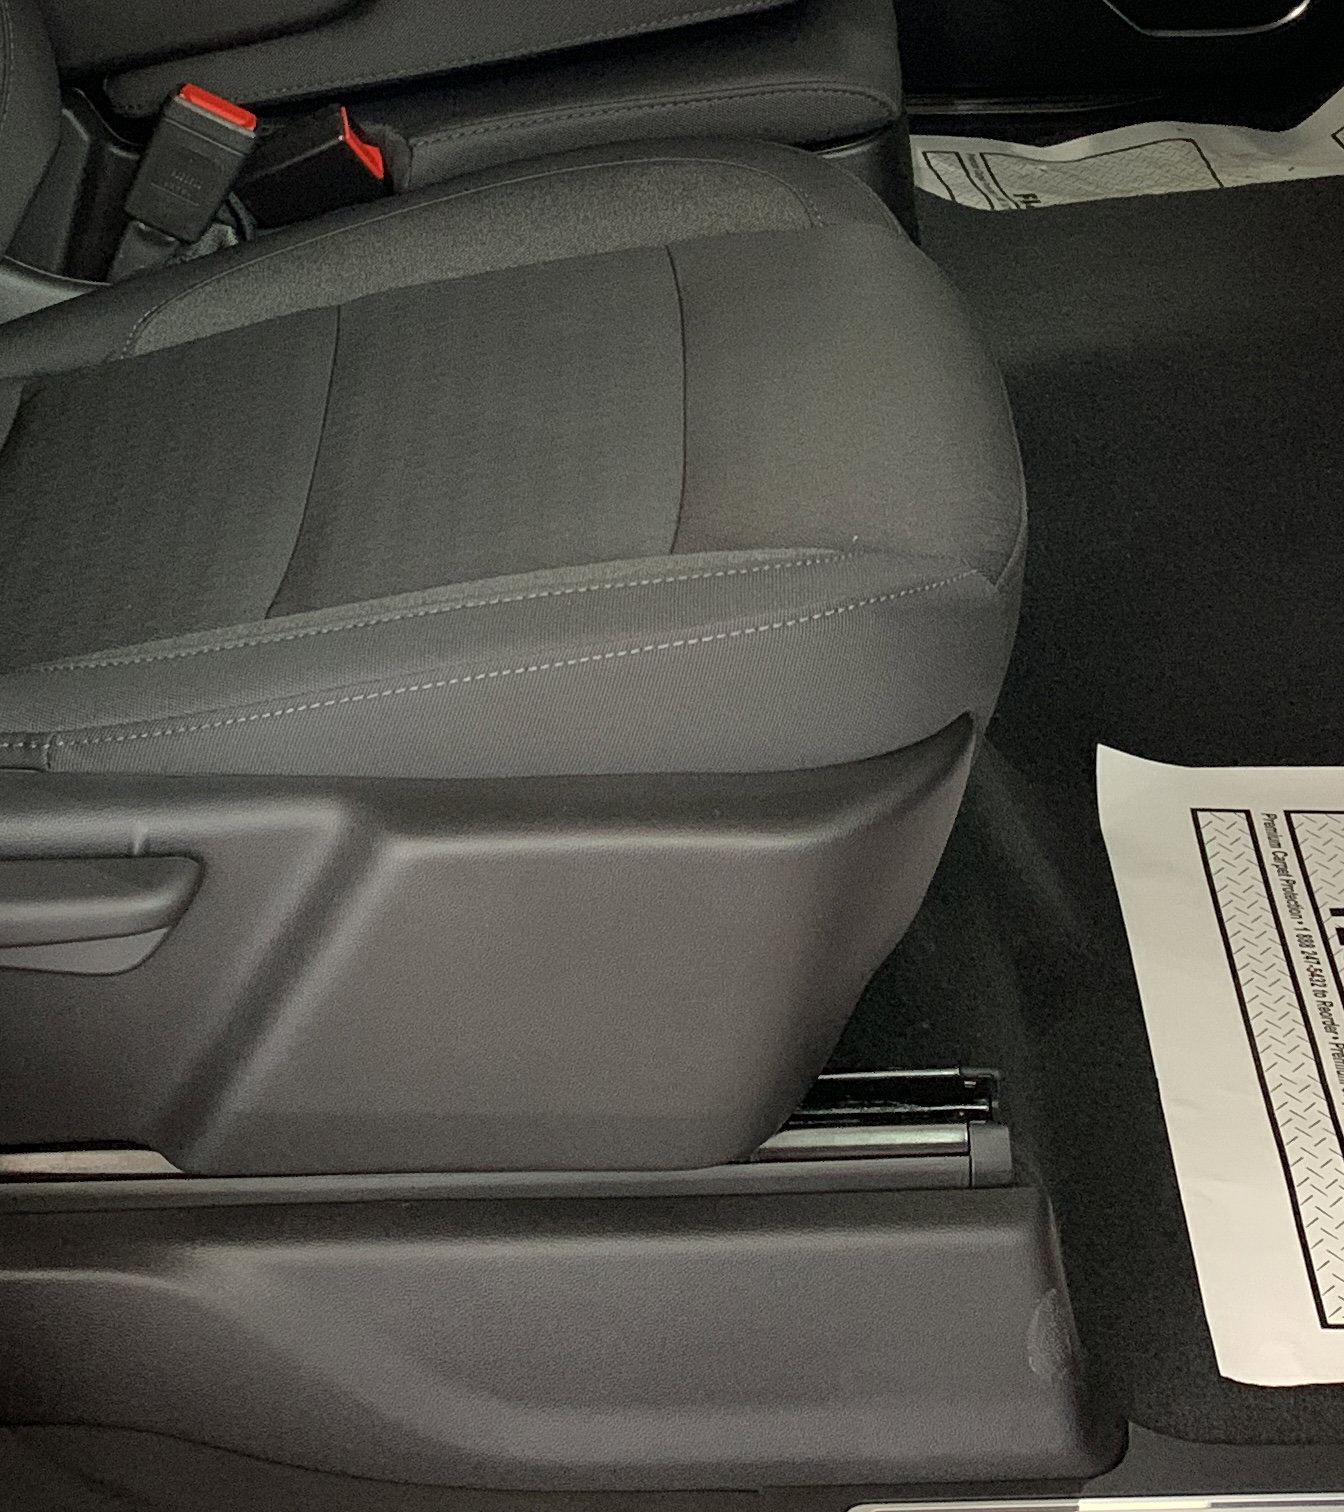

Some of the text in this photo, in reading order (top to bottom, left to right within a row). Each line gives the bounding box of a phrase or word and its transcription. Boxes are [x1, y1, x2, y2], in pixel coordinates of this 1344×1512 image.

[1261, 812, 1283, 849] Premium
[1271, 850, 1293, 877] Carpet
[1279, 877, 1305, 920] Protection
[1314, 989, 1328, 999] to
[1316, 999, 1341, 1036] Reorder
